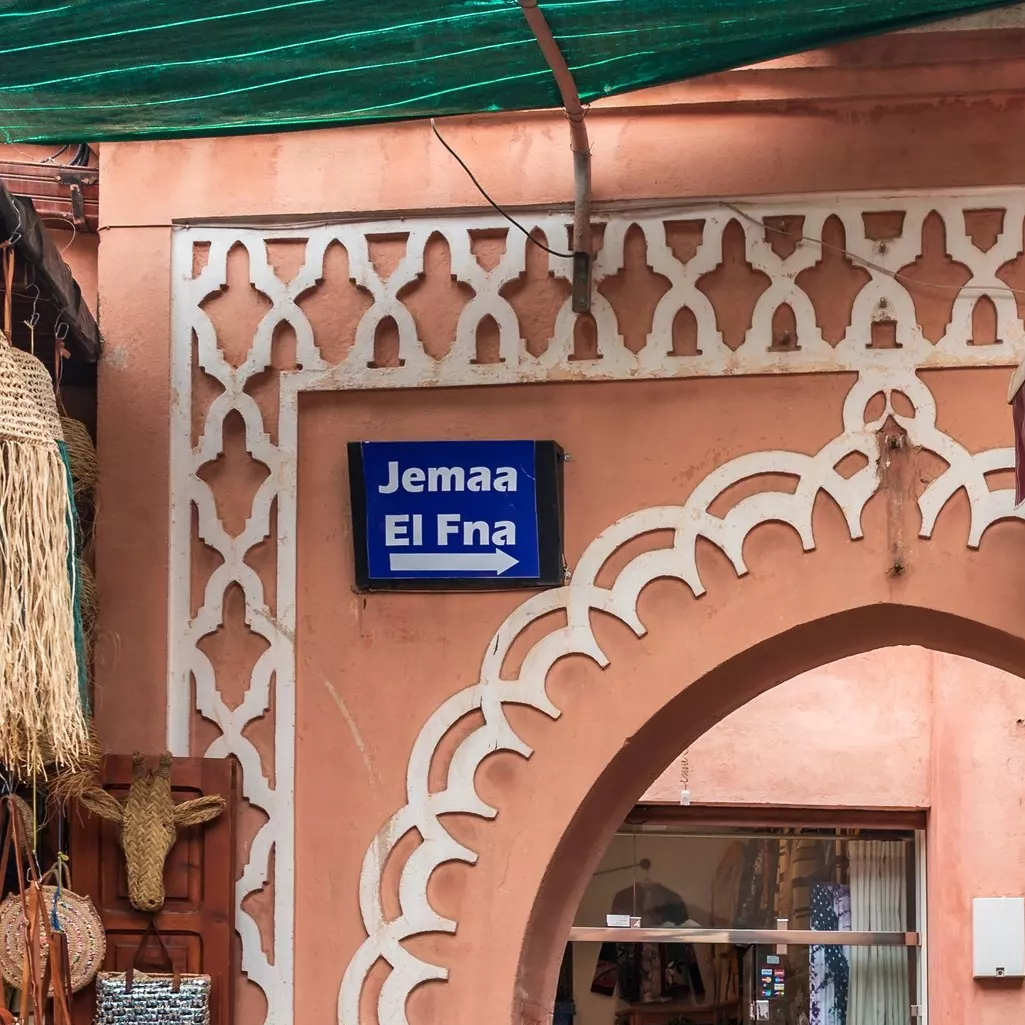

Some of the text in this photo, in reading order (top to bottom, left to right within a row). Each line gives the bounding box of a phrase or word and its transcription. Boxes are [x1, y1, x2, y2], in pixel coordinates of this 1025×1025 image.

[378, 461, 518, 494] Jemaa
[385, 514, 516, 546] El Fna
